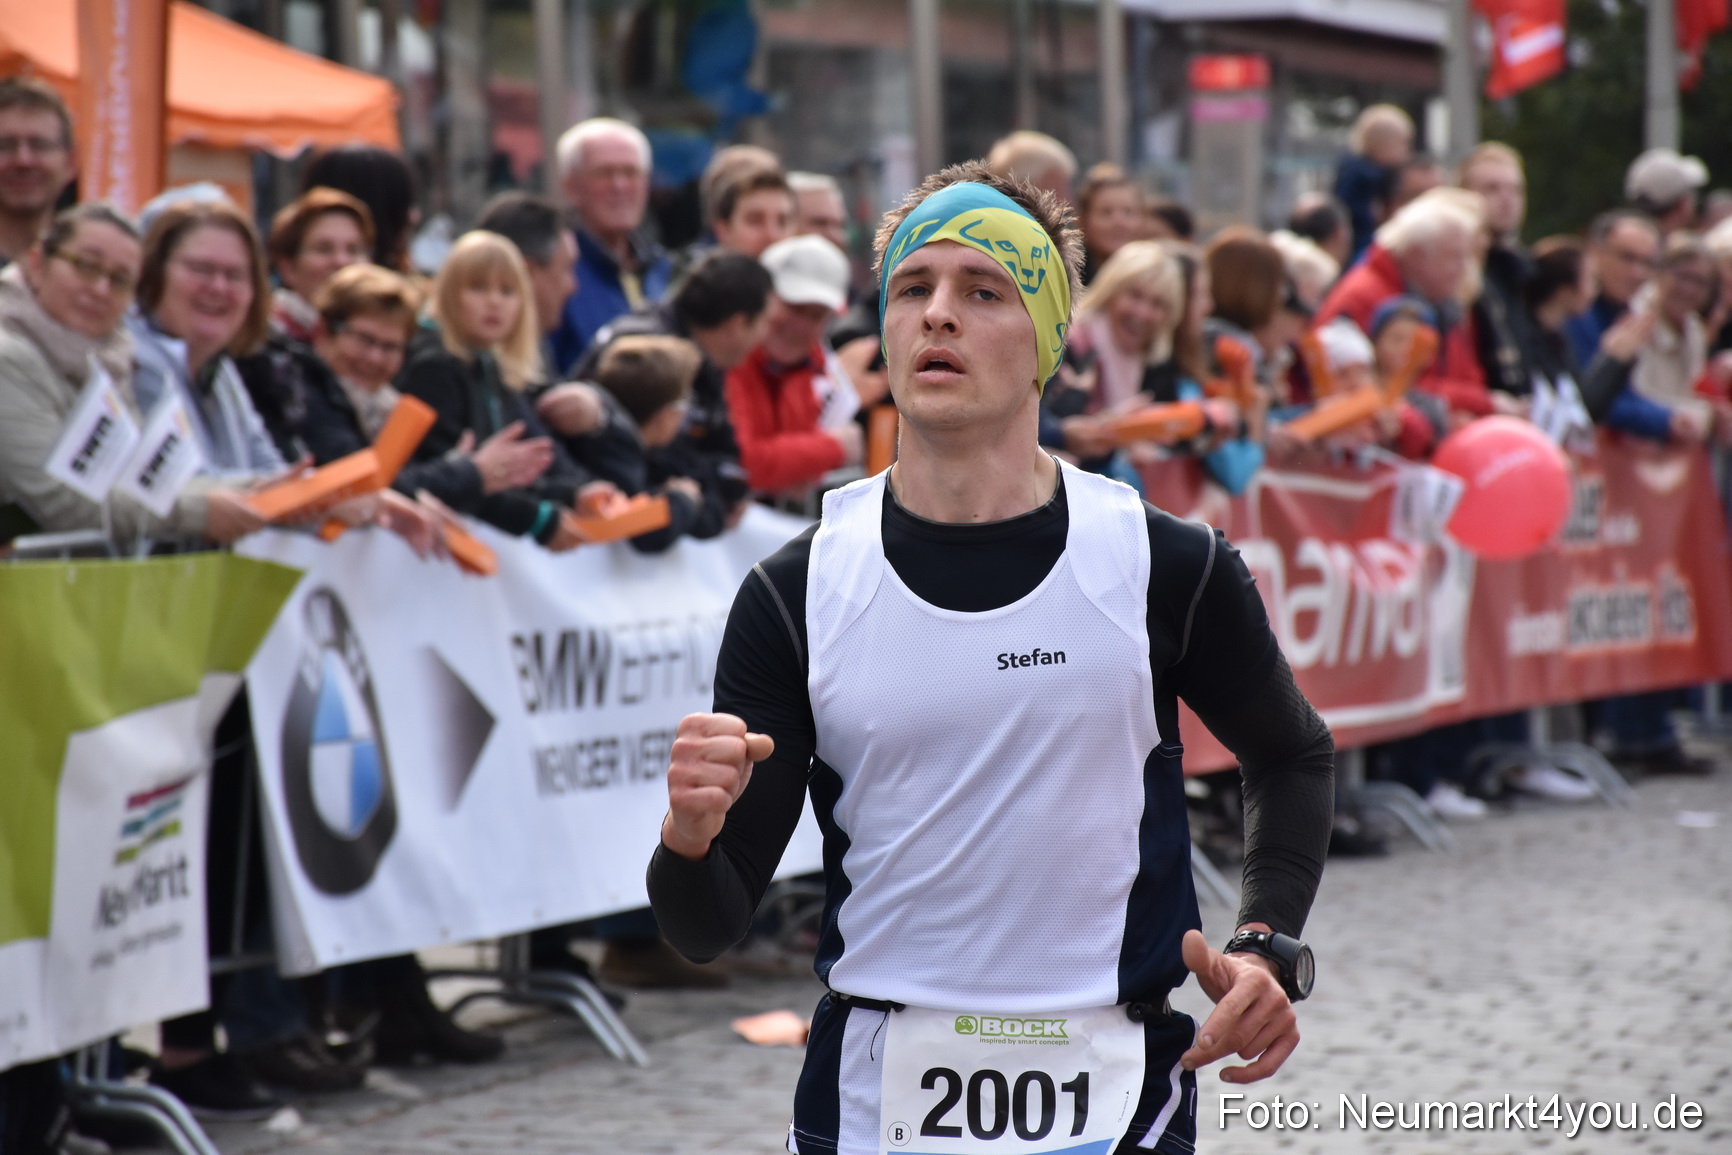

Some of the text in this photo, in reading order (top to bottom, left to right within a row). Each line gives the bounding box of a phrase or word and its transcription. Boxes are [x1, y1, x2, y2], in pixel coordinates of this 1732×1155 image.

[511, 626, 611, 714] BMW
[997, 648, 1066, 671] Stefan
[980, 1016, 1068, 1038] BOCK
[980, 1037, 1006, 1045] inspired
[1008, 1037, 1016, 1045] by
[1039, 1038, 1070, 1046] concepts
[920, 1067, 1090, 1141] 2001
[895, 1128, 904, 1141] B
